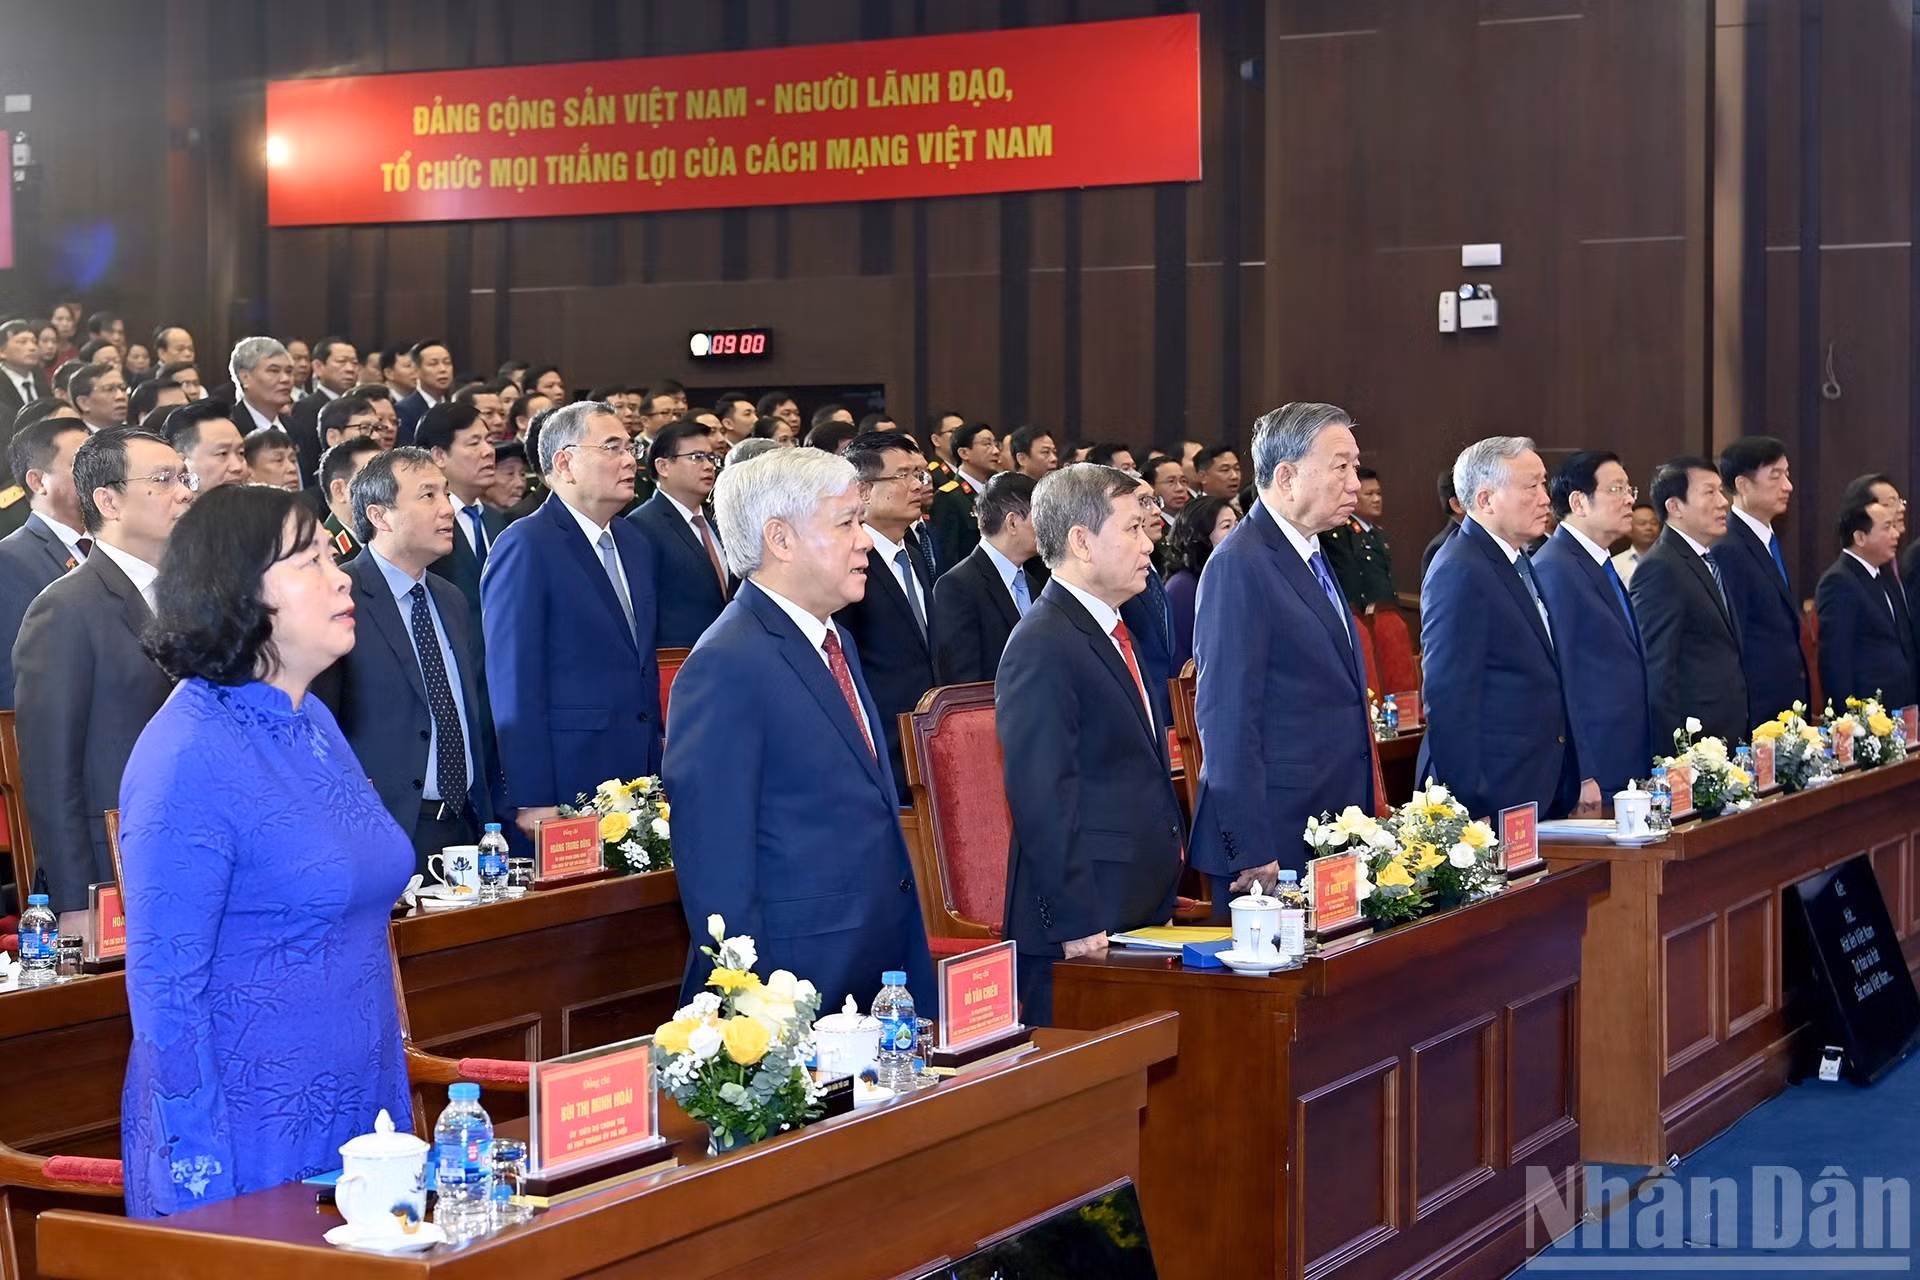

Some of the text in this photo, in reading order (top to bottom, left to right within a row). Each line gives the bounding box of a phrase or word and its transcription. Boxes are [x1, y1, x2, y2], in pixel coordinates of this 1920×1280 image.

[412, 96, 480, 136] ĐẢNG
[488, 97, 556, 137] CỘNG
[564, 86, 616, 126] SẢN
[624, 86, 679, 128] VIỆT
[687, 88, 747, 118] NAM
[776, 72, 858, 113] NGƯỜI
[867, 70, 940, 108] LÃNH
[949, 67, 1013, 107] ĐẠO,
[380, 125, 1053, 193] TỔ CHỨC MỌI THẮNG LỢI CỦA CÁCH MẠNG VIỆT NAM
[560, 1086, 633, 1122] BÙI THỊ MINH HOÀI
